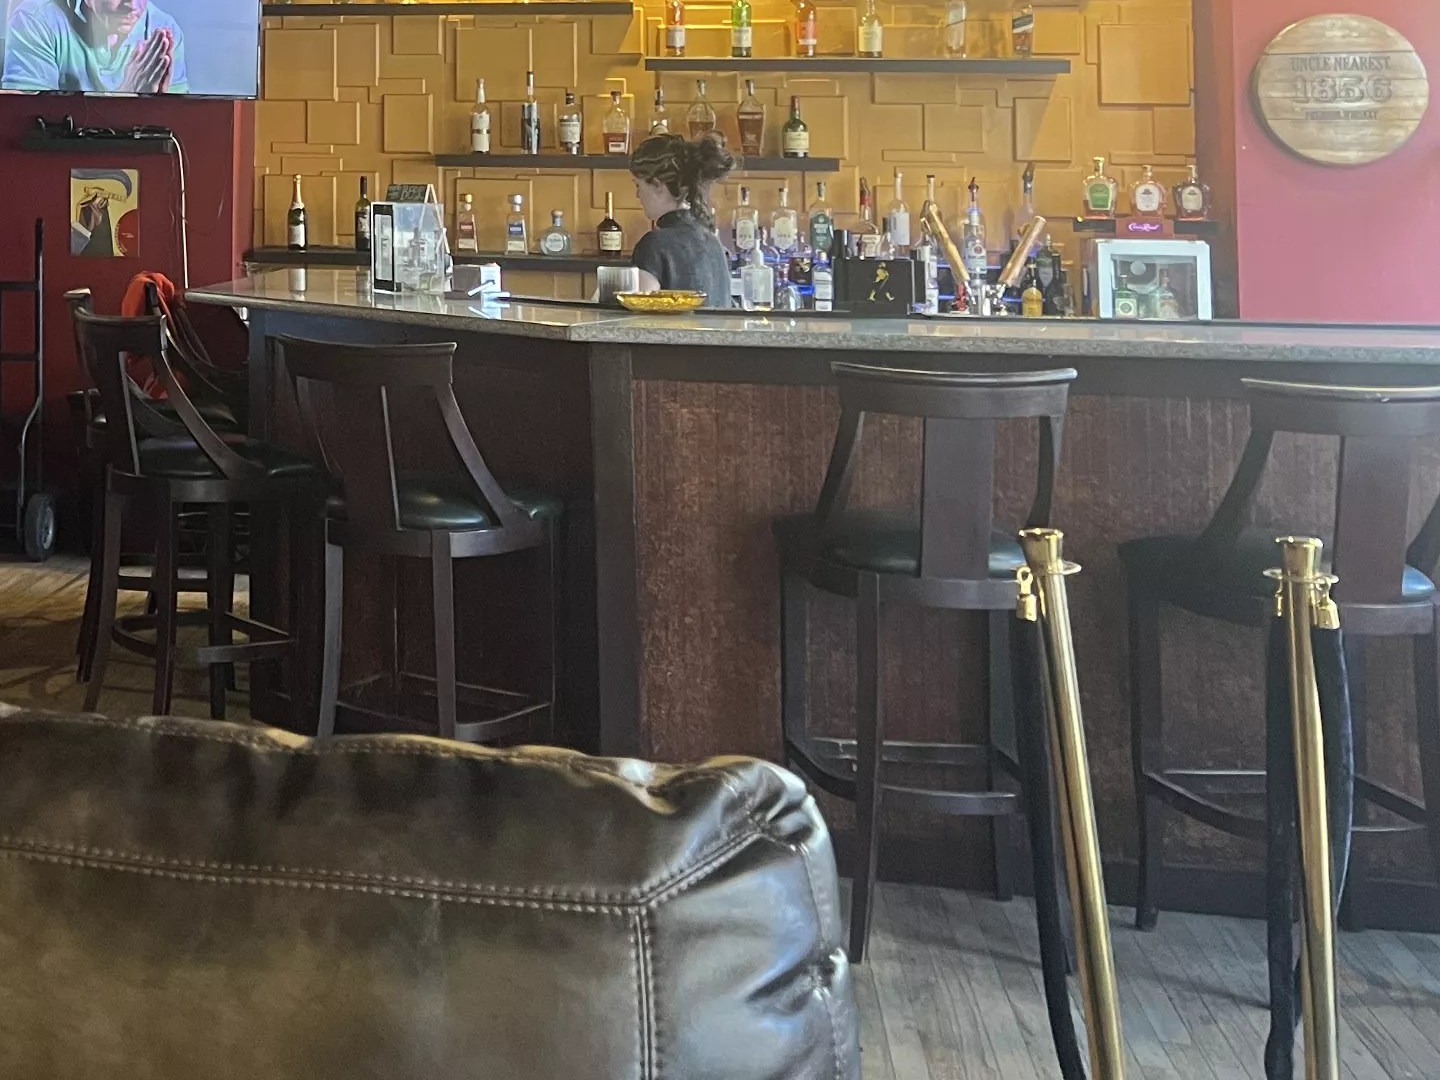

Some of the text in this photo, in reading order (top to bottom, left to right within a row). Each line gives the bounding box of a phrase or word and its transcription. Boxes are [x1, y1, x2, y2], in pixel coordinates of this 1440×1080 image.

[1289, 55, 1391, 72] UNCLE NEAREST
[1292, 75, 1393, 104] 1856
